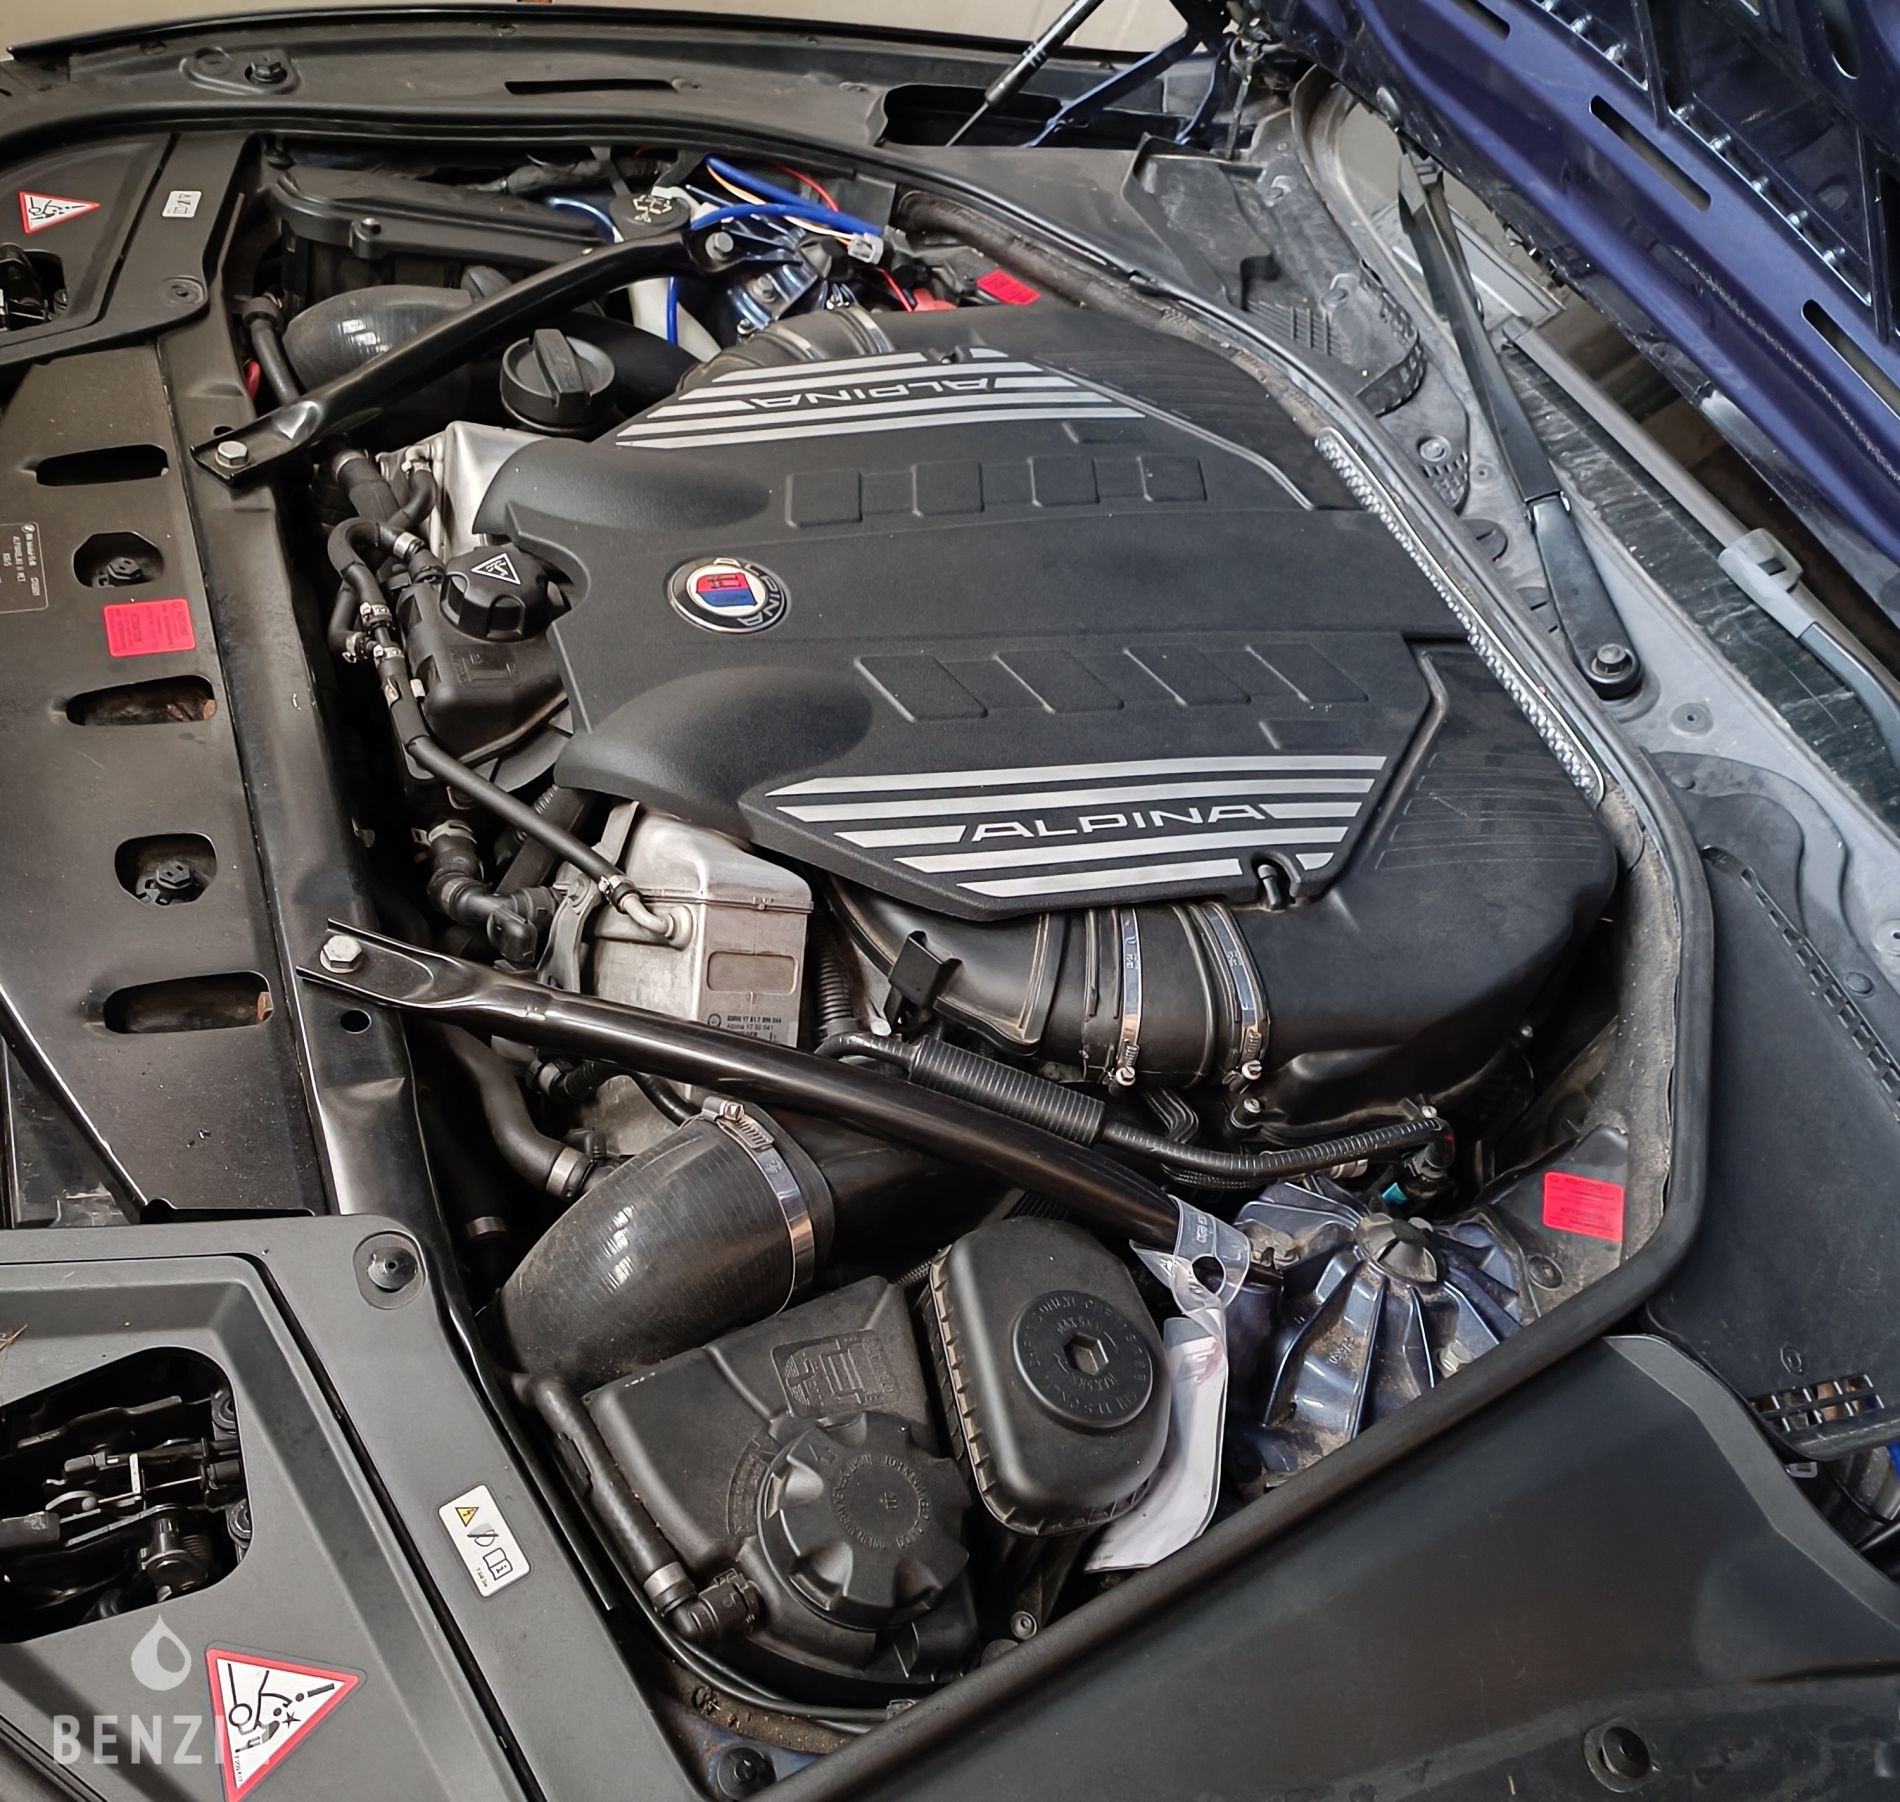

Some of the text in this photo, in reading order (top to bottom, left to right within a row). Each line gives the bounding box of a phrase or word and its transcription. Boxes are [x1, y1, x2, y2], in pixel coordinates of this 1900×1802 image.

[750, 377, 990, 410] ALPINA
[713, 557, 781, 627] ALPINA
[971, 804, 1266, 842] ALPINA
